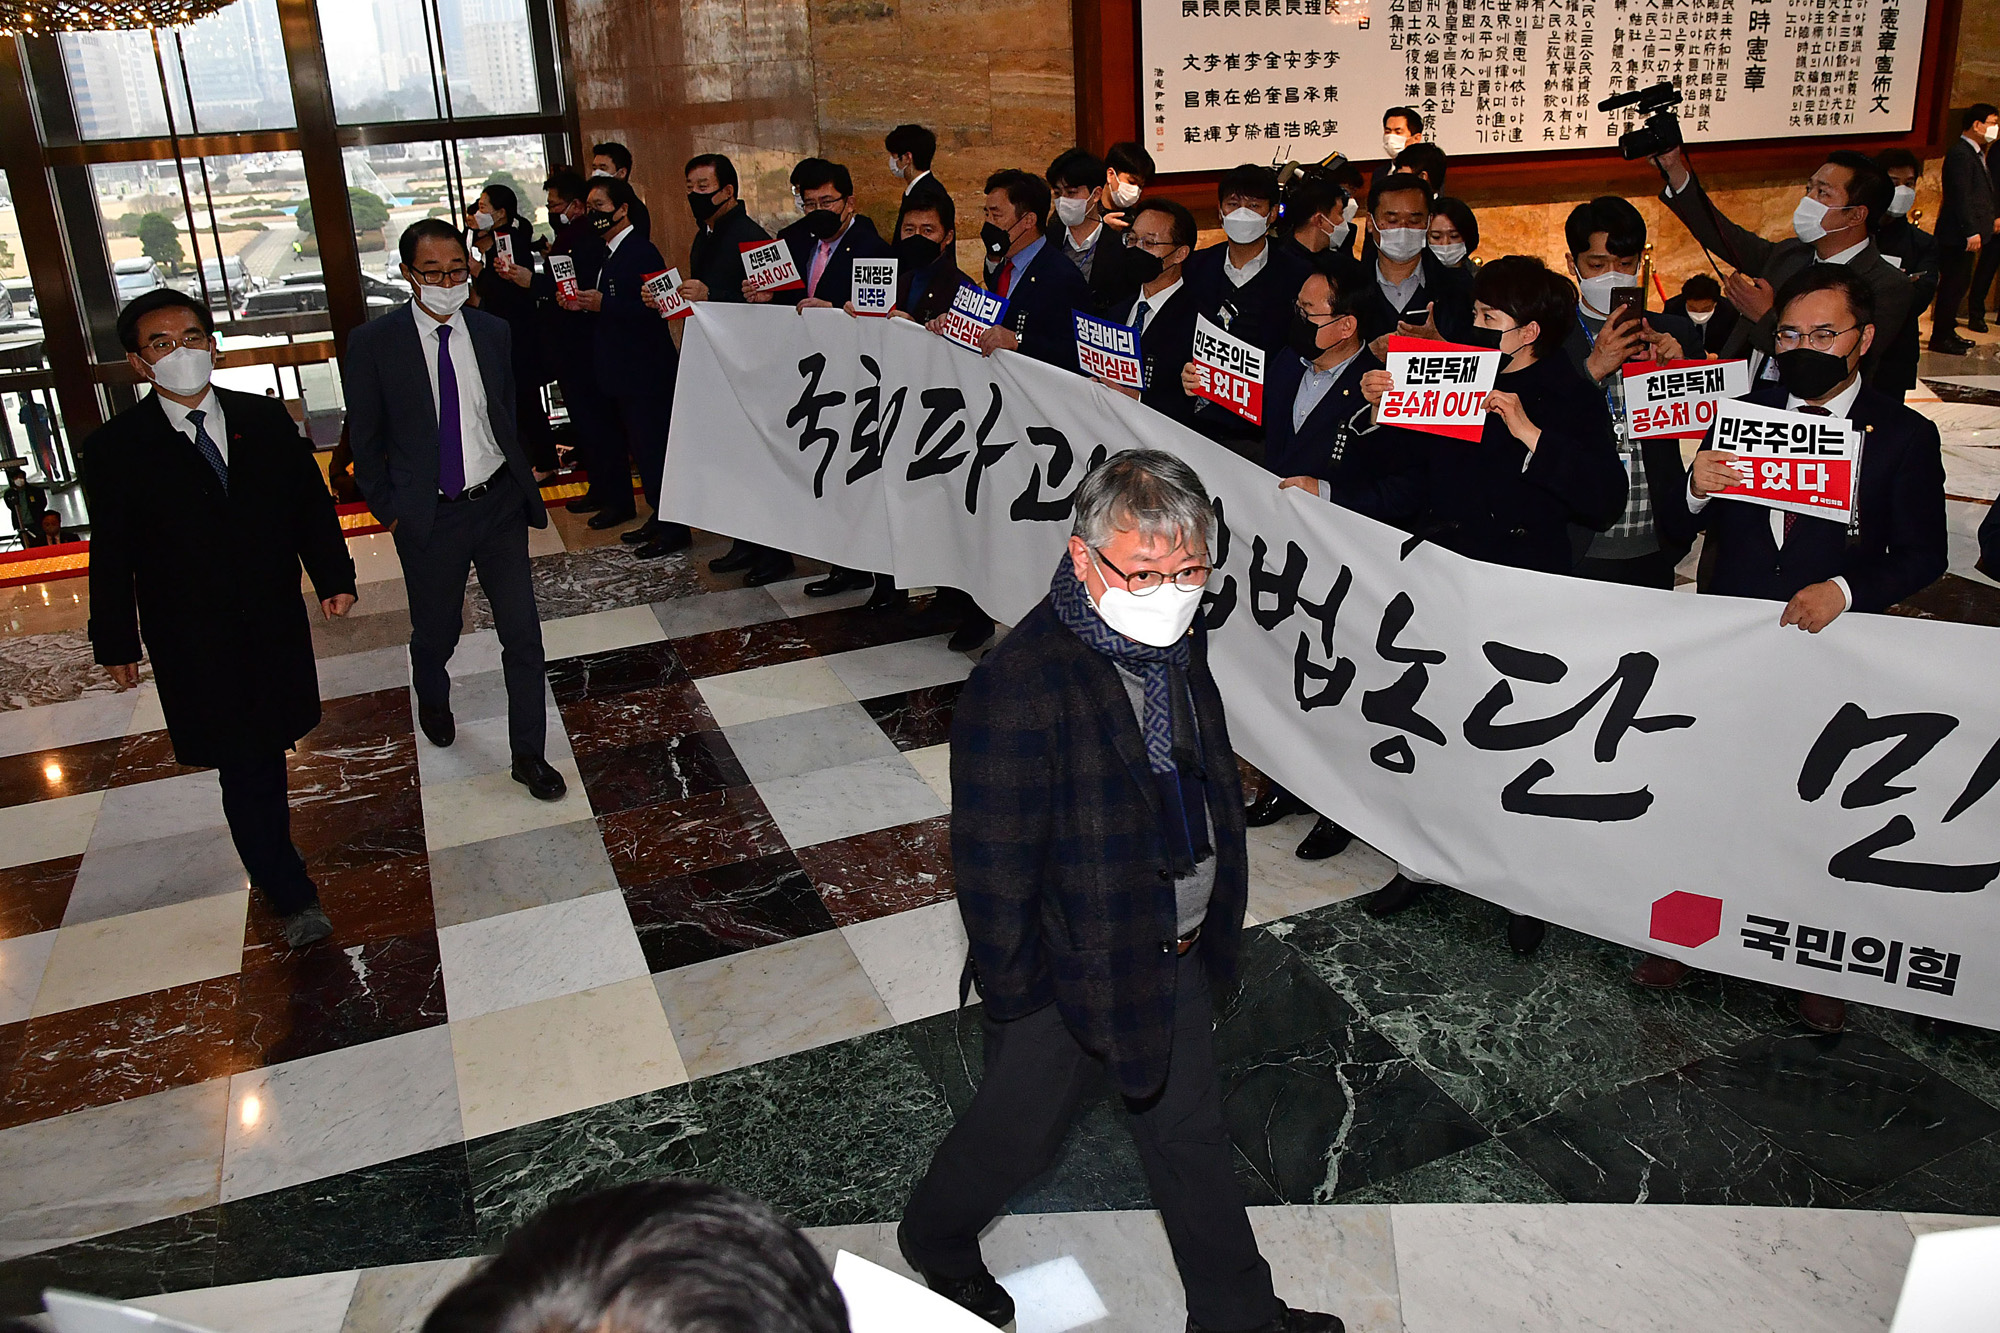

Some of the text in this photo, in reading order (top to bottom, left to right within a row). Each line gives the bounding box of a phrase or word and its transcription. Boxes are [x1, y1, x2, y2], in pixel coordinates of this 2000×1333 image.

[1744, 0, 1772, 93] 時憲章
[748, 244, 781, 270] 친문독재
[648, 274, 674, 298] 문독재
[748, 262, 796, 289] 공수처 OUT
[854, 265, 894, 286] 독재정당
[858, 288, 887, 307] 민주당
[953, 285, 1002, 323] 정권비리
[1076, 315, 1135, 356] 정권비리
[1079, 345, 1138, 384] 국민심판
[1195, 329, 1260, 379] 민주주의는
[1406, 355, 1480, 385] 친문독재
[1195, 363, 1250, 407] 죽었다
[1646, 367, 1725, 402] 친문독재
[1383, 390, 1487, 418] 공수처 OUT
[1632, 401, 1690, 433] 공수처
[1718, 417, 1844, 456] 민주주의는
[1797, 702, 2000, 893] 민
[1739, 914, 1962, 996] 국민의힘
